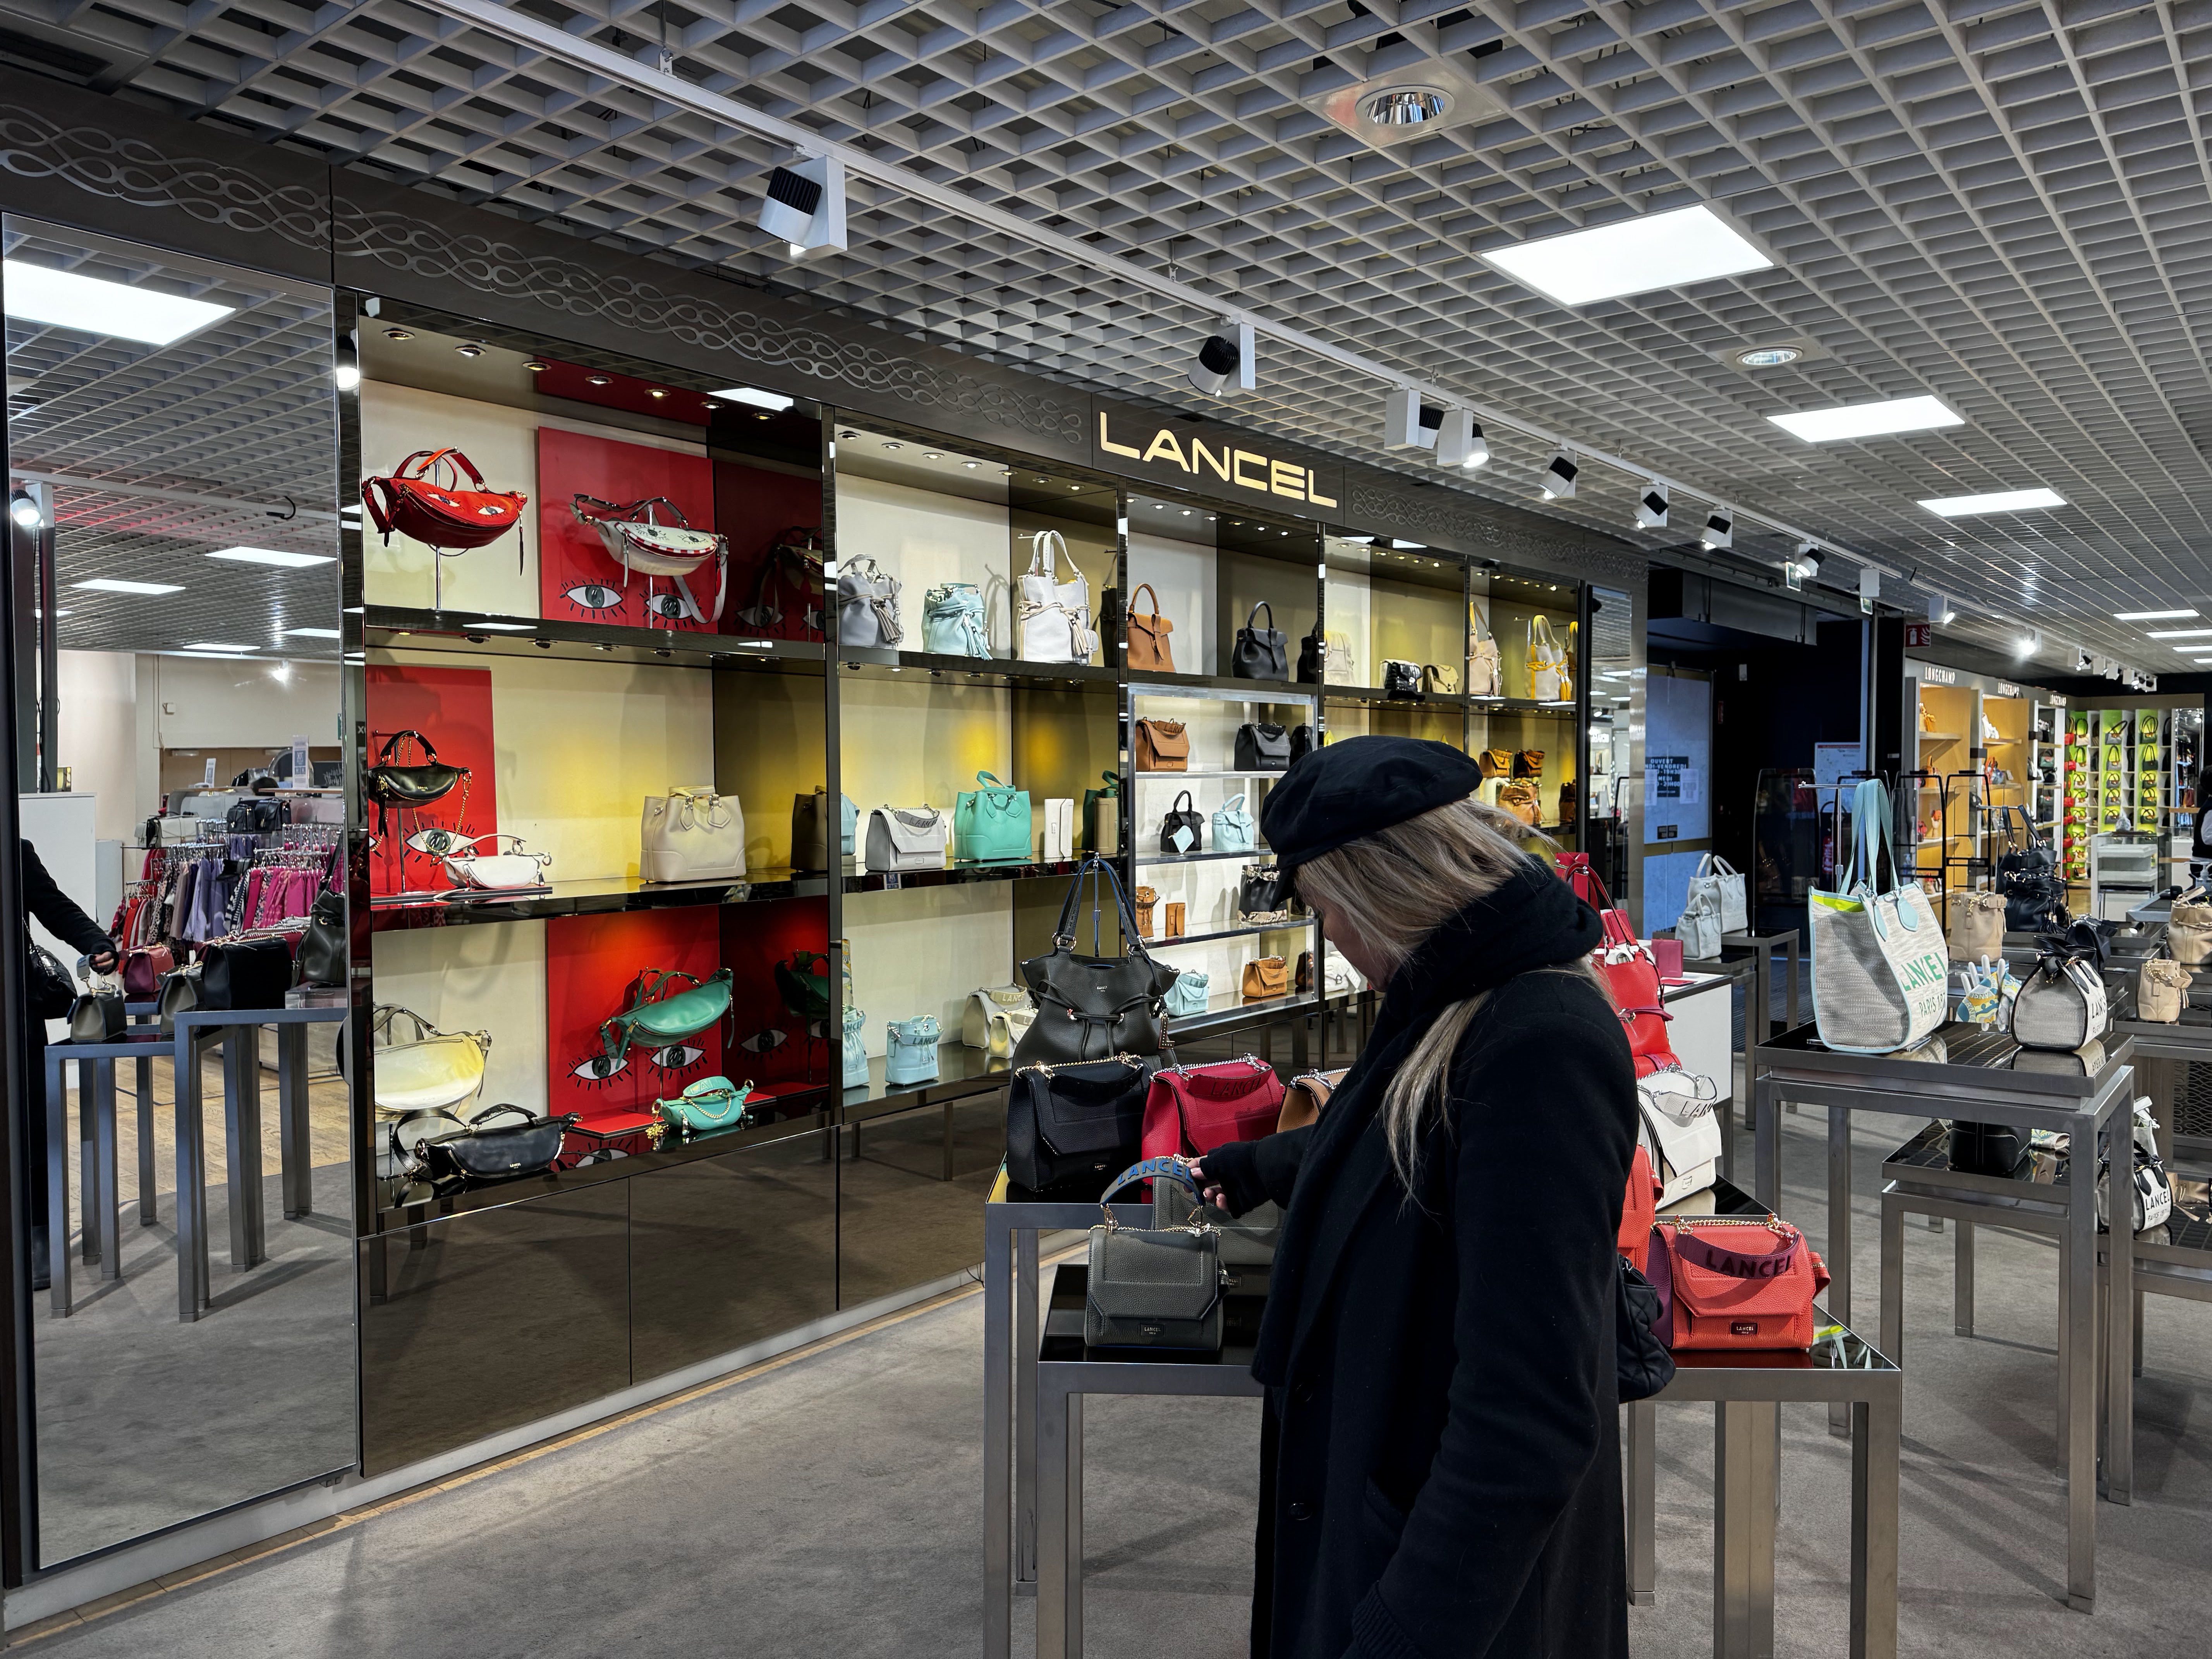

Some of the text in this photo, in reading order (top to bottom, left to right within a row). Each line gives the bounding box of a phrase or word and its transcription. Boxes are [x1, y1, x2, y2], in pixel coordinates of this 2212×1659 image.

[1100, 412, 1337, 508] LANCEL
[1925, 666, 1955, 685] LONGCHAMP
[1998, 682, 2019, 697] LONGCHAMP
[1919, 996, 1936, 1018] PARIS
[1118, 1158, 1194, 1185] LANCEL
[2145, 1190, 2169, 1211] LANCEL
